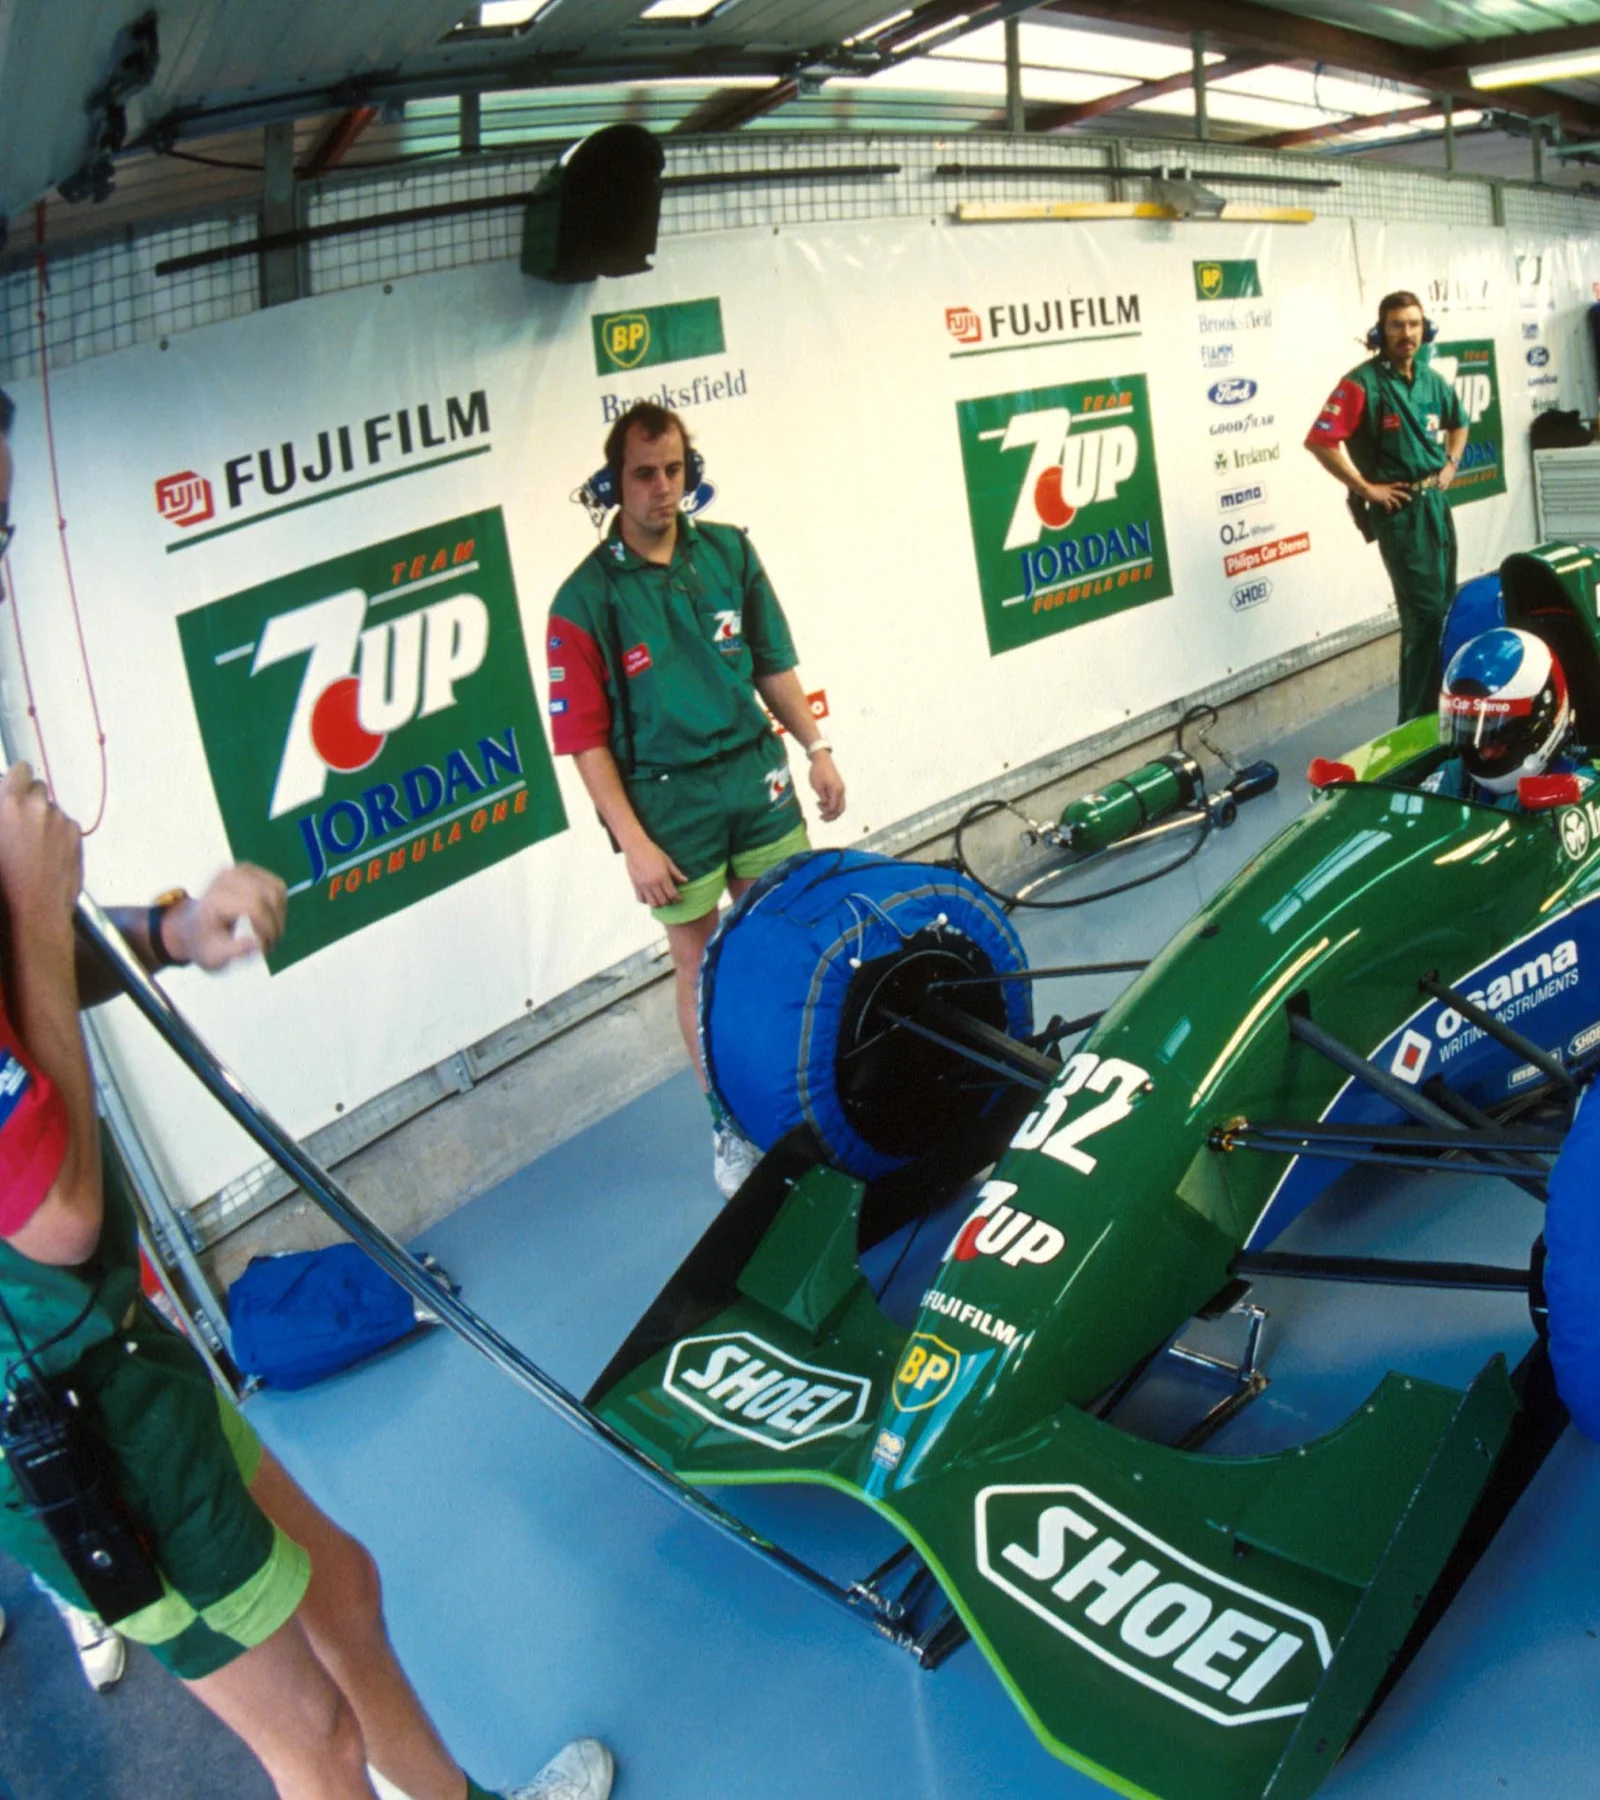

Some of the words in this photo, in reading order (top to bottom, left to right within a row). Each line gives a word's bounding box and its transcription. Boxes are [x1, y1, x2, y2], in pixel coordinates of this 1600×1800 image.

[1202, 269, 1221, 289] BP
[611, 322, 645, 353] BP
[988, 294, 1142, 338] FUJIFILM
[1082, 391, 1133, 413] TEAM
[1212, 379, 1252, 403] Ford
[158, 476, 206, 521] FUJI
[224, 389, 492, 509] FUJIFILM
[999, 406, 1139, 552] 7UP
[1233, 441, 1281, 469] Ireland
[391, 538, 476, 586] TEAM
[1020, 519, 1153, 600] JORDAN
[1261, 544, 1278, 562] Car
[1278, 537, 1309, 557] Stereo
[1031, 575, 1114, 615] FORMULA
[1234, 581, 1268, 608] SHOEI
[248, 586, 490, 820] 7UP
[1451, 697, 1471, 712] Car
[1473, 698, 1511, 713] Stereo
[296, 726, 524, 885] JORDAN
[328, 821, 463, 901] FORMULA
[469, 788, 530, 834] ONE
[1434, 938, 1579, 1040] osama
[1009, 1052, 1151, 1176] 32
[941, 1180, 1065, 1268] 7UP
[925, 1288, 1021, 1346] FUJIFILM
[680, 1344, 853, 1436] SHOEI
[898, 1345, 950, 1392] BP
[1000, 1505, 1304, 1704] SHOEI
